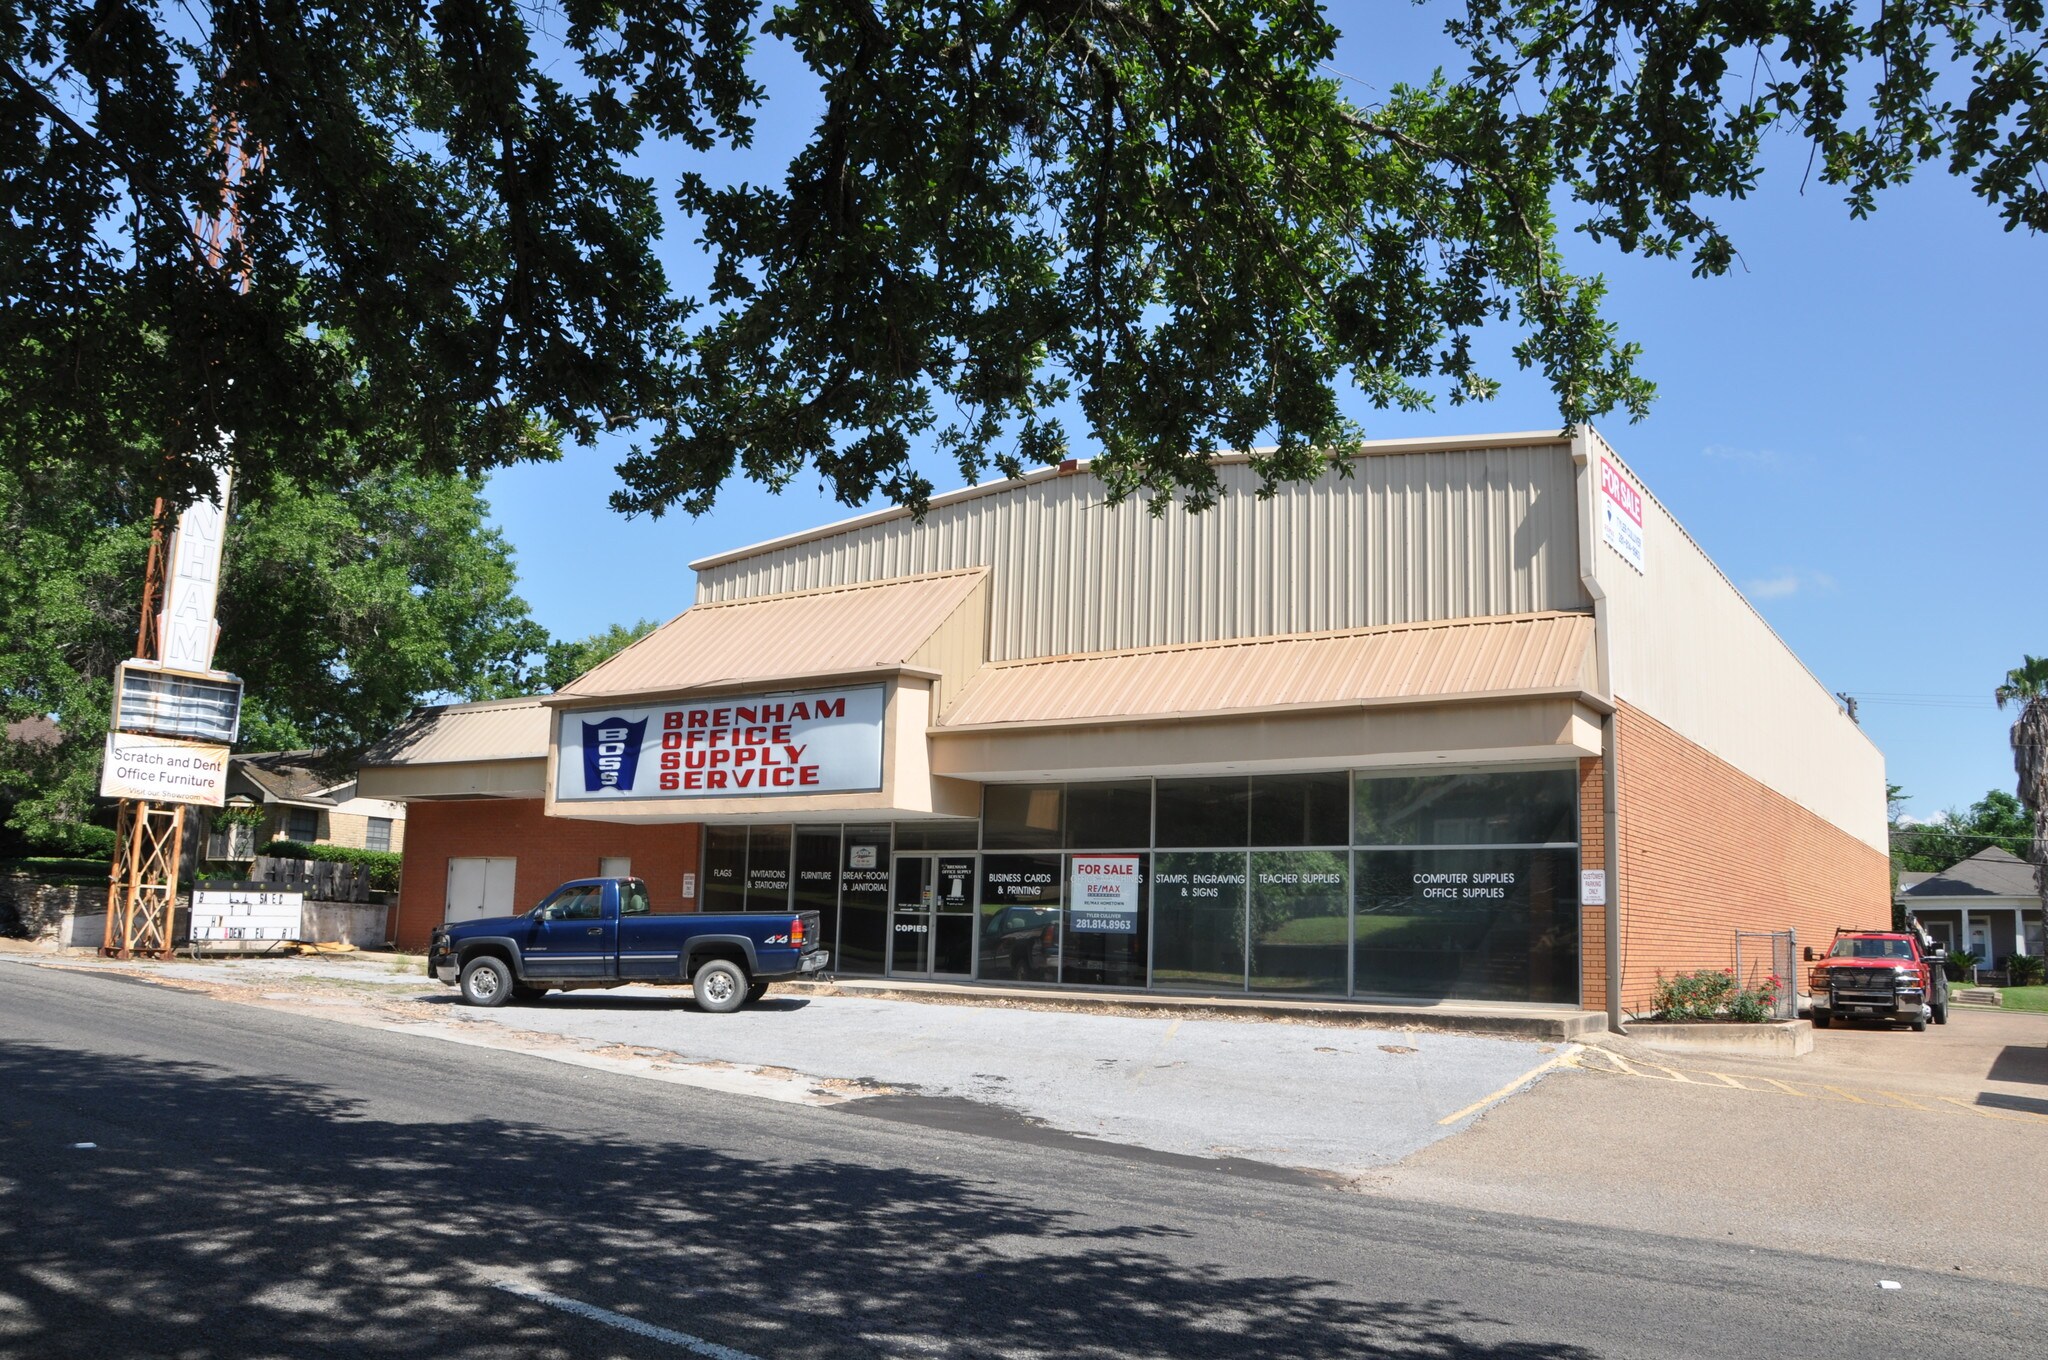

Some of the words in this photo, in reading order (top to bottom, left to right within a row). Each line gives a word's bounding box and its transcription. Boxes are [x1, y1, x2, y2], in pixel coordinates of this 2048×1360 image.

[1601, 461, 1620, 502] FOR
[1620, 481, 1641, 523] SALE
[663, 697, 846, 730] BRENHAM
[661, 724, 793, 750] OFFICE
[114, 748, 163, 765] Scratch
[166, 757, 190, 768] and
[193, 758, 221, 772] Dent
[597, 728, 628, 786] BOSS
[660, 744, 807, 770] SUPPLY
[116, 766, 156, 782] Office
[159, 771, 215, 788] Furniture
[659, 764, 820, 790] SERVICE
[128, 787, 146, 796] Visit
[162, 791, 201, 800] Showroom
[713, 868, 732, 878] FLAGS
[750, 869, 786, 879] INVITATIONS
[1078, 864, 1101, 875] FOR
[1103, 864, 1133, 875] SALE
[800, 871, 832, 881] FURNITURE
[842, 871, 889, 881] BREAK-ROOM
[989, 873, 1021, 882] BUSINESS
[1024, 873, 1051, 883] CARDS
[1155, 874, 1190, 885] STAMPS,
[1193, 874, 1246, 884] ENGRAVING
[1259, 873, 1298, 884] TEACHER
[1302, 873, 1340, 884] SUPPLIES
[1413, 873, 1468, 884] COMPUTER
[1472, 872, 1515, 884] SUPPLIES
[747, 881, 752, 889] &
[754, 880, 789, 890] STATIONERY
[842, 883, 848, 891] &
[850, 882, 888, 892] JANITORIAL
[997, 885, 1004, 894] &
[1007, 885, 1041, 895] PRINTING
[1087, 884, 1121, 893] RE/MAX
[1181, 888, 1188, 897] &
[1192, 887, 1219, 898] SIGNS
[1423, 887, 1458, 898] OFFICE
[1462, 887, 1505, 898] SUPPLIES
[895, 924, 928, 933] COPIES
[1076, 919, 1131, 930] 281.814.8963
[229, 927, 246, 939] DENT
